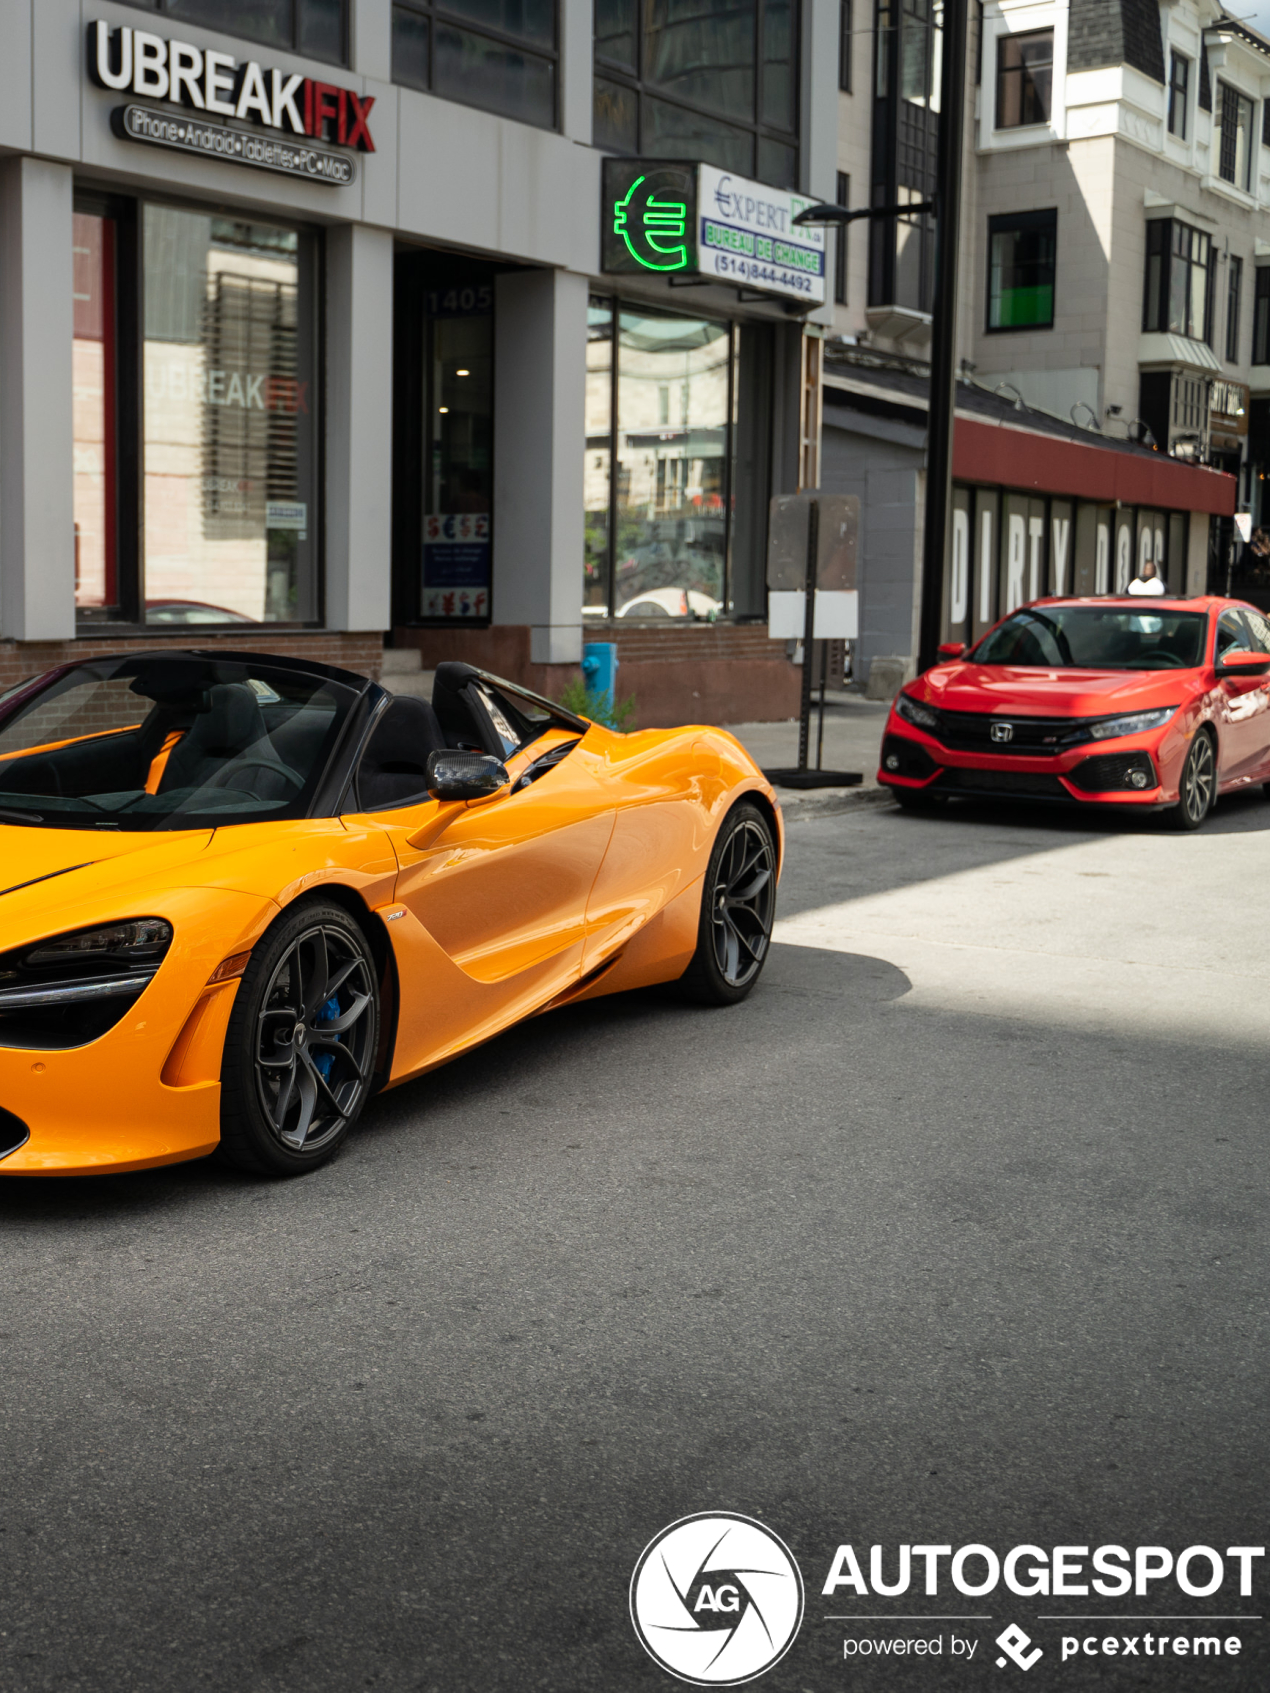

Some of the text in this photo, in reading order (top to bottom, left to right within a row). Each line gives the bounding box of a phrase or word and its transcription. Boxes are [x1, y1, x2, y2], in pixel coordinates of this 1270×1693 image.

[96, 19, 376, 152] UBREAKIFIX
[705, 223, 820, 272] BUREAU DE CHANGE
[714, 253, 812, 292] (514)844-4492
[428, 286, 491, 313] 1405
[951, 508, 1070, 624] DIRTY
